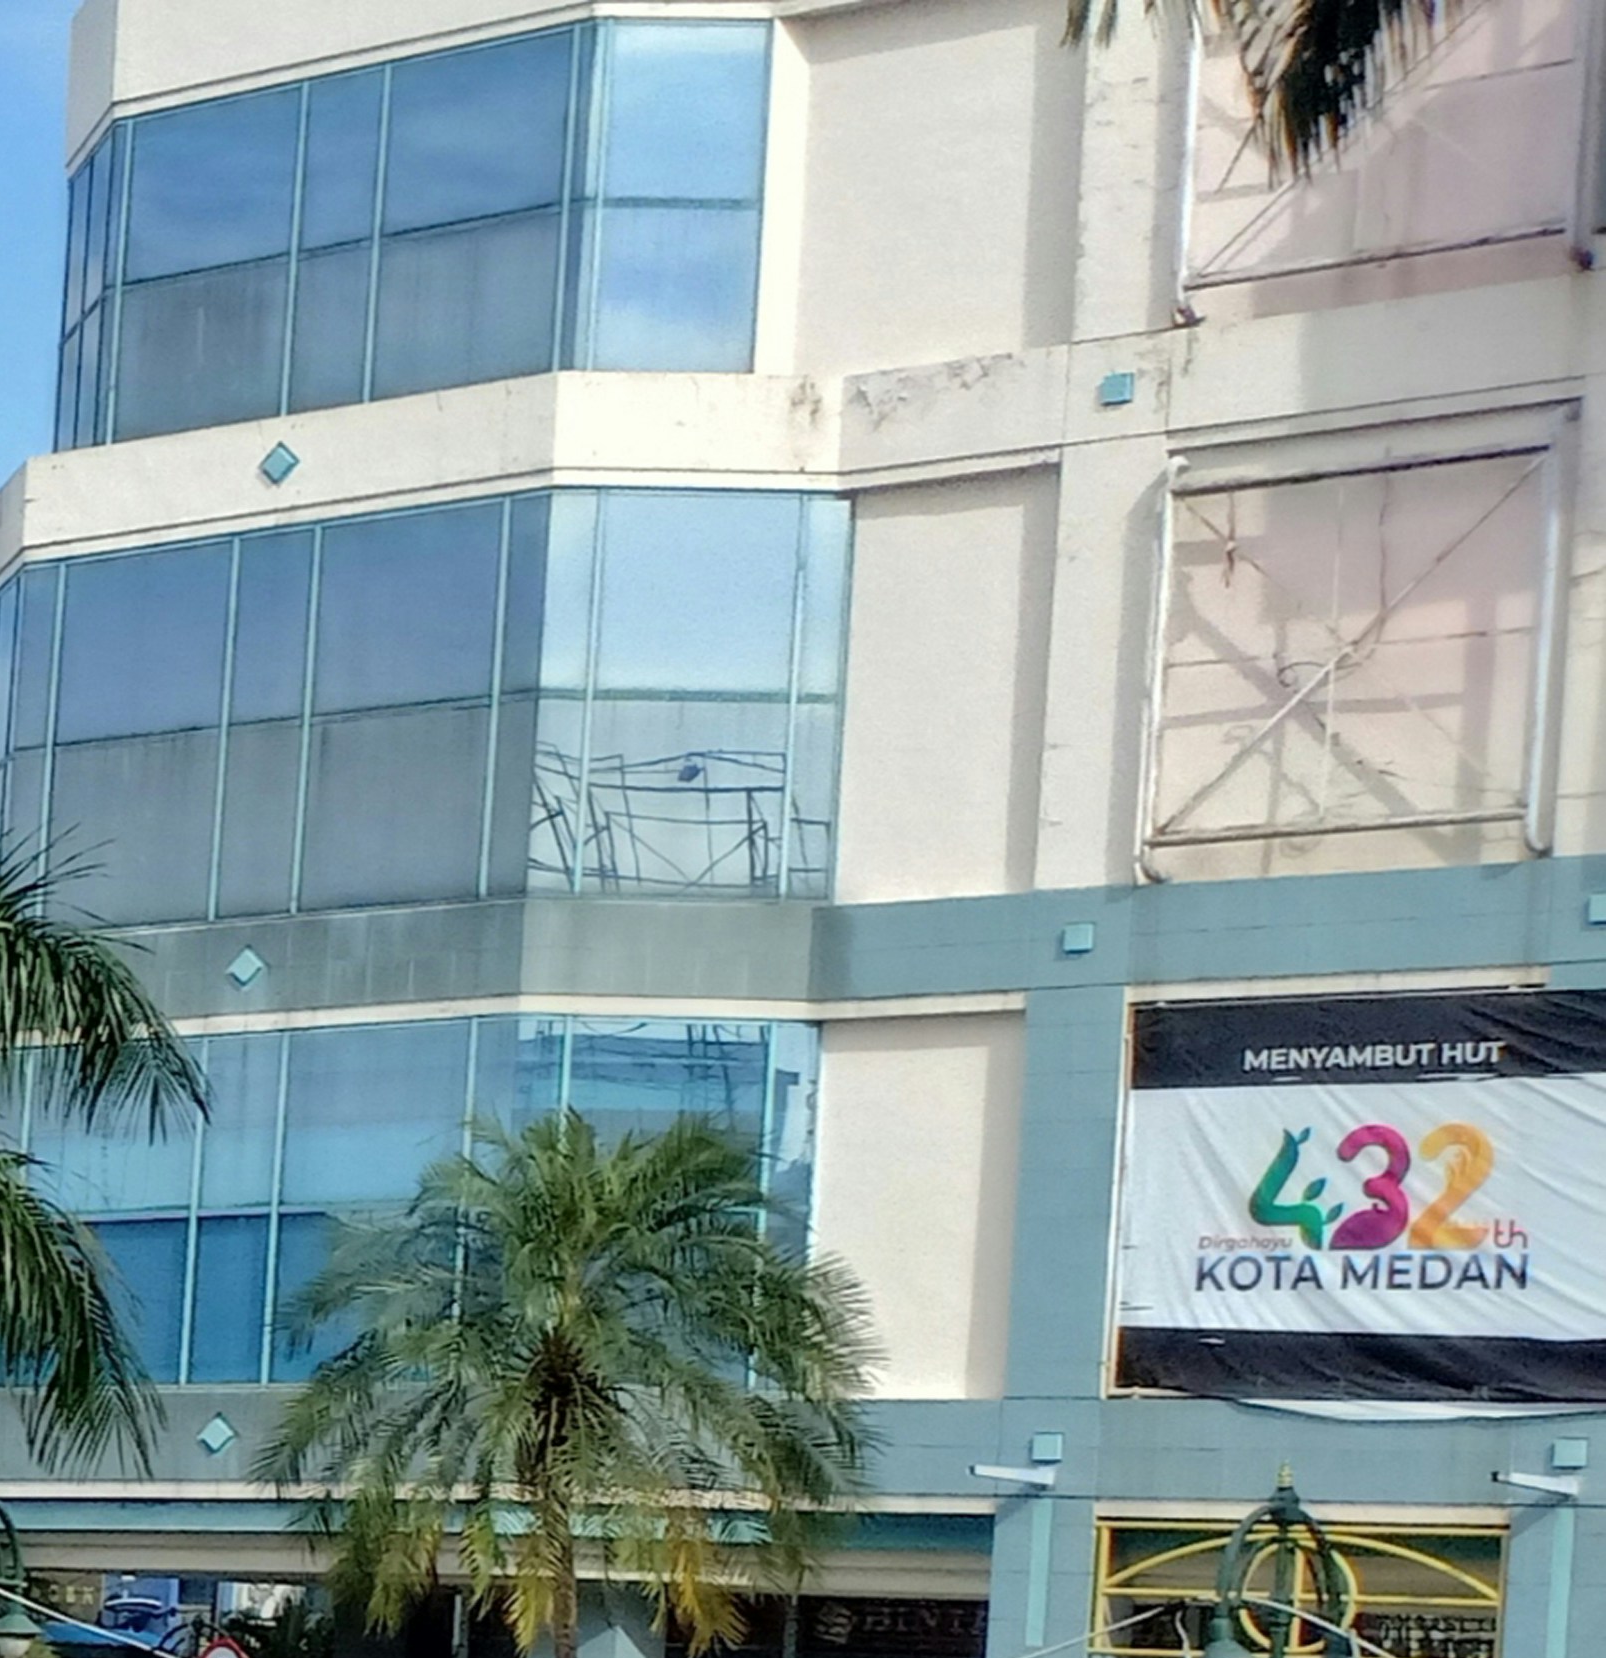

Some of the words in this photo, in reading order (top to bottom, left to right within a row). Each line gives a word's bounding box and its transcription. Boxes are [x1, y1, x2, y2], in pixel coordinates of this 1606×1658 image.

[1243, 1044, 1436, 1072] MENYAMBUT
[1440, 1040, 1506, 1066] HUT
[1198, 1234, 1293, 1252] Dirgahayu
[1195, 1255, 1323, 1292] KOTA
[1340, 1254, 1529, 1291] MEDAN
